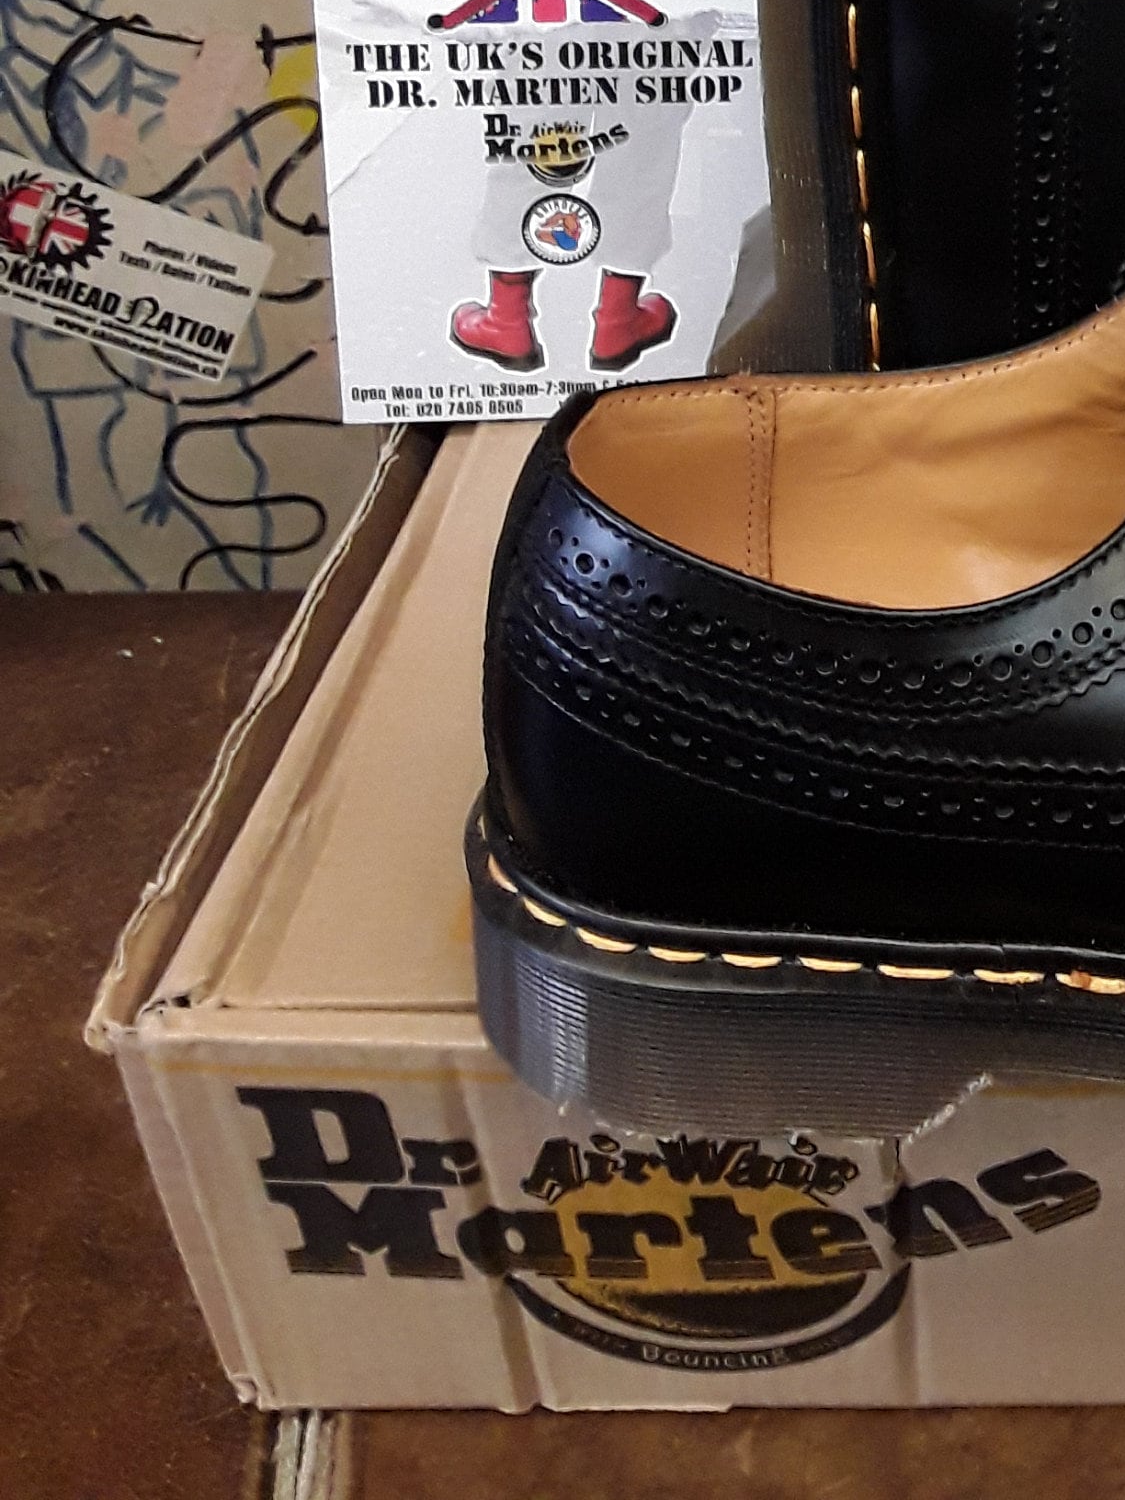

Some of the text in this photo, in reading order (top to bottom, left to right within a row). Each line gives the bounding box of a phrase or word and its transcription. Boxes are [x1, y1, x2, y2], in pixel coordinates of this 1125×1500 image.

[346, 38, 754, 73] THE UK'S ORIGINAL
[367, 74, 743, 108] DR. MARTEN SHOP
[485, 123, 630, 164] Martens
[351, 386, 387, 404] Open
[392, 385, 423, 400] Mon
[428, 385, 444, 399] to
[520, 1130, 860, 1205] AirWair
[266, 1146, 1102, 1280] Martens
